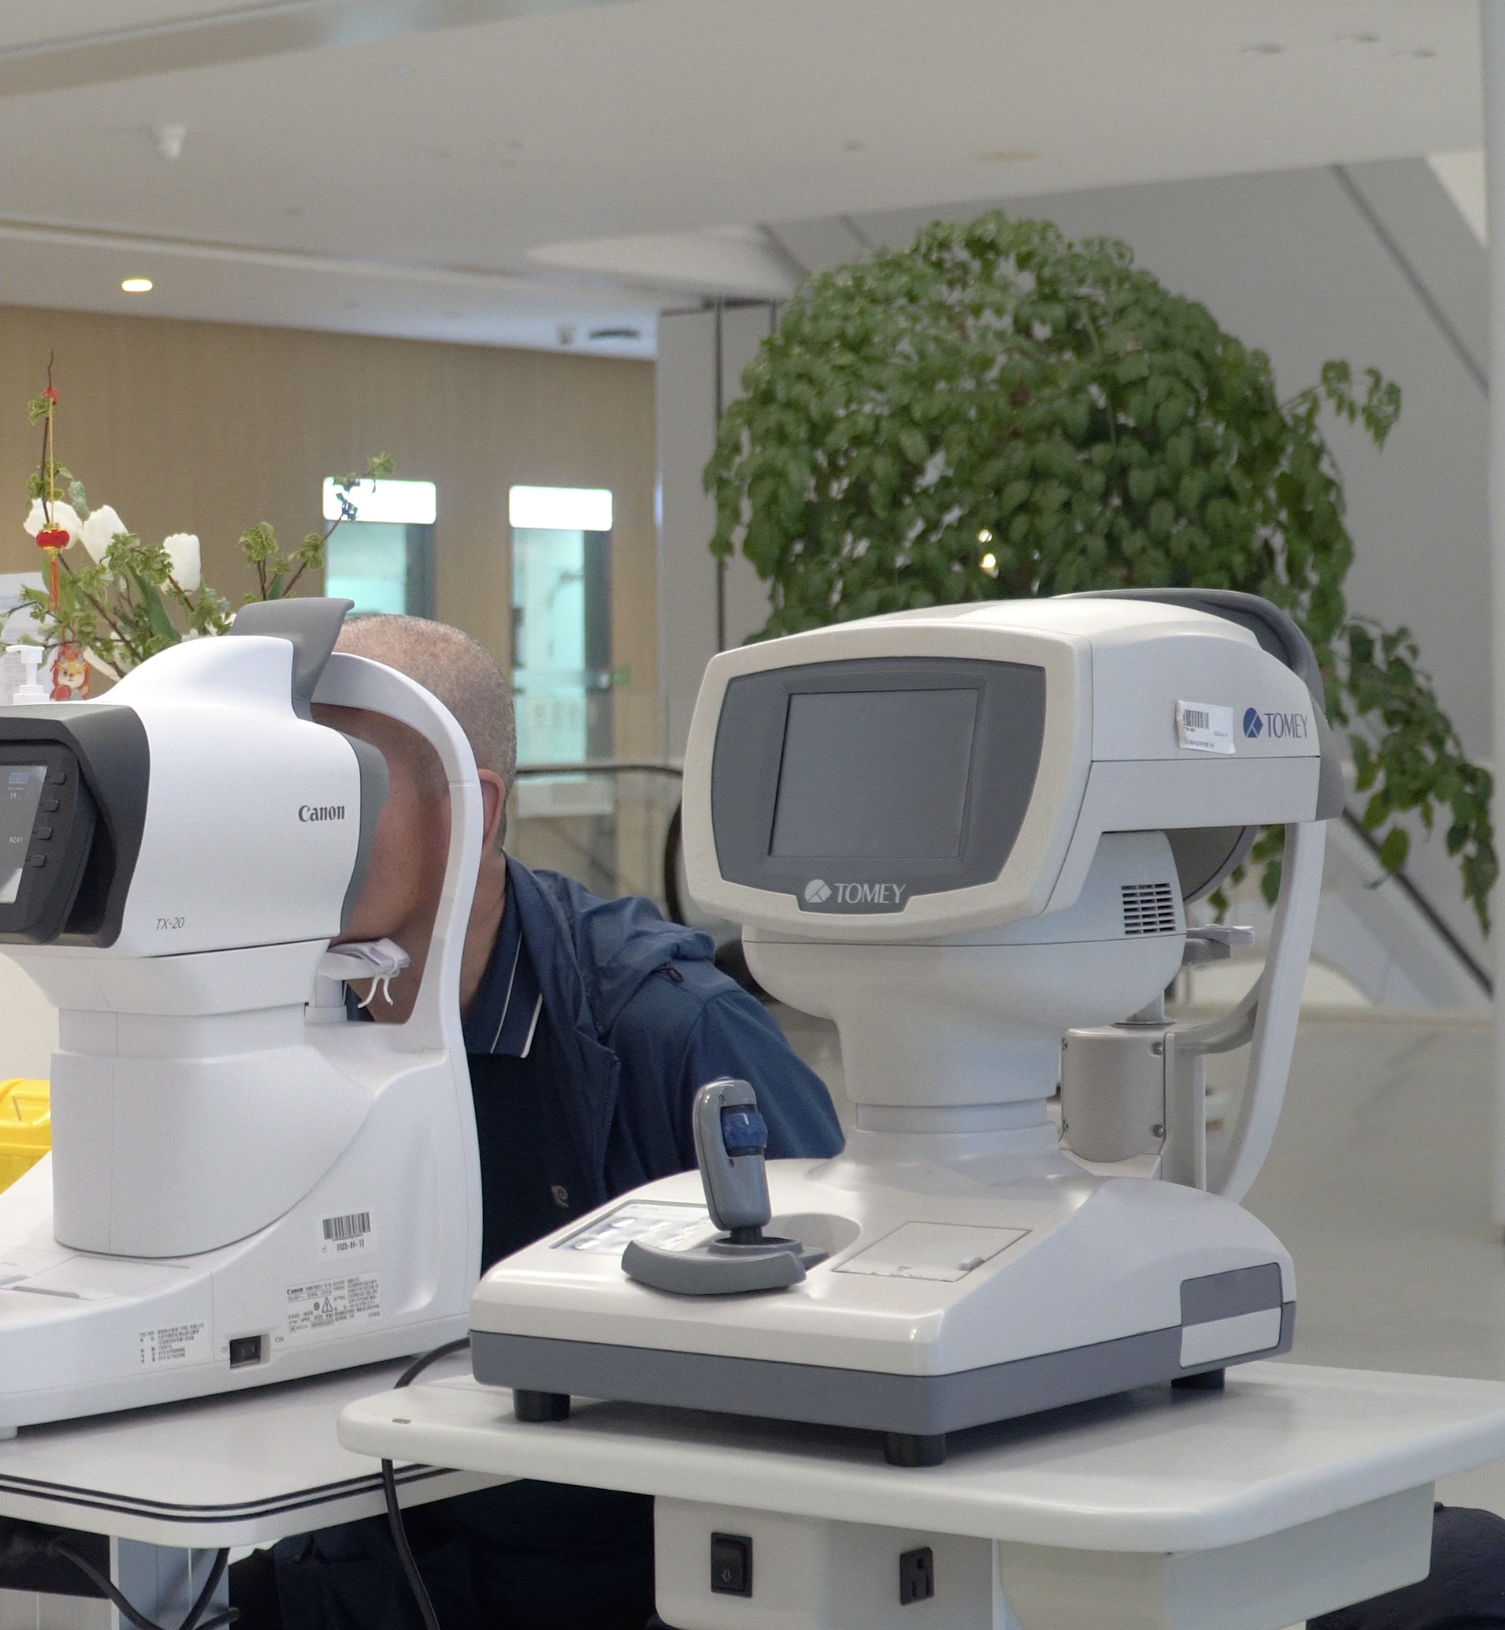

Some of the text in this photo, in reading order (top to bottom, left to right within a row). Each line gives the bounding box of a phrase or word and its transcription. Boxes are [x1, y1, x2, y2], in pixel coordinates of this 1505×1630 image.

[1264, 712, 1308, 738] TOMEY
[298, 805, 345, 822] Canon
[835, 883, 906, 903] TOMEY
[156, 916, 185, 930] TX-20
[286, 1287, 304, 1295] Canon
